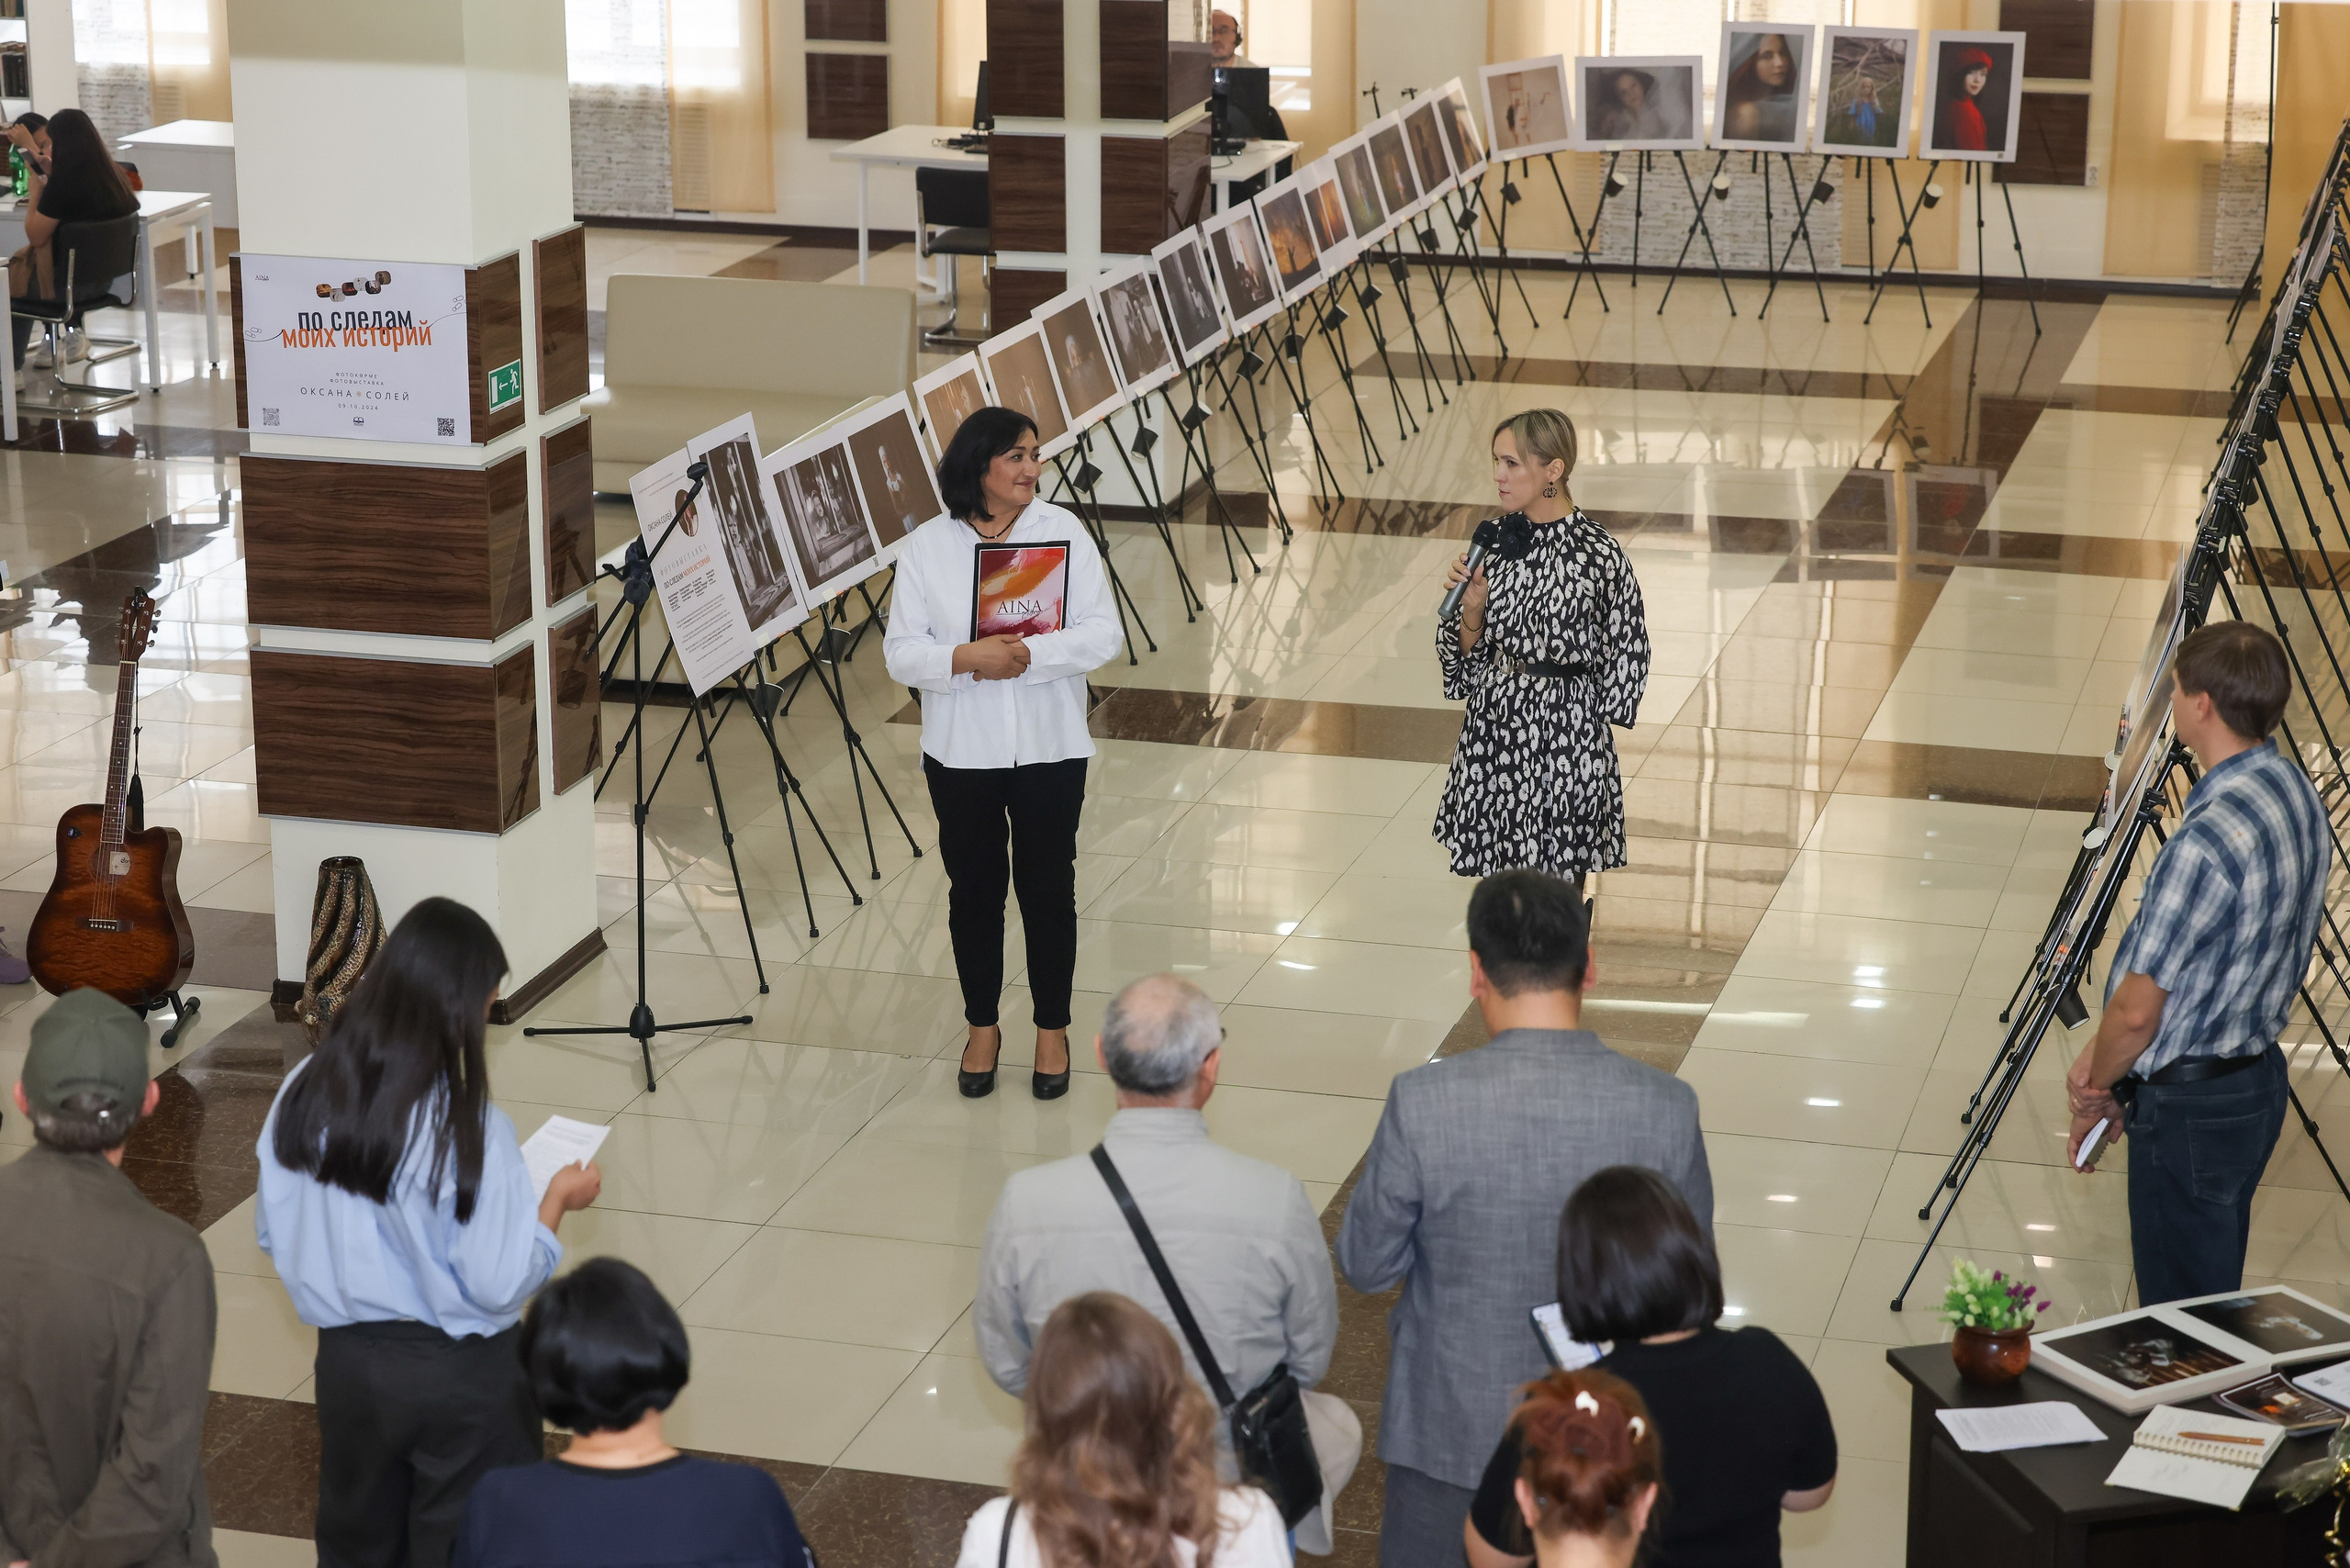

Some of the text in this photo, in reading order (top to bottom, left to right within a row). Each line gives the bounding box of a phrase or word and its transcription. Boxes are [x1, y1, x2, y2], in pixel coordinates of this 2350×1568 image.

[331, 310, 413, 334] следам
[282, 320, 432, 353] моих историй
[300, 387, 409, 401] ОКСАНА СОЛЕЙ
[998, 599, 1043, 613] AINA
